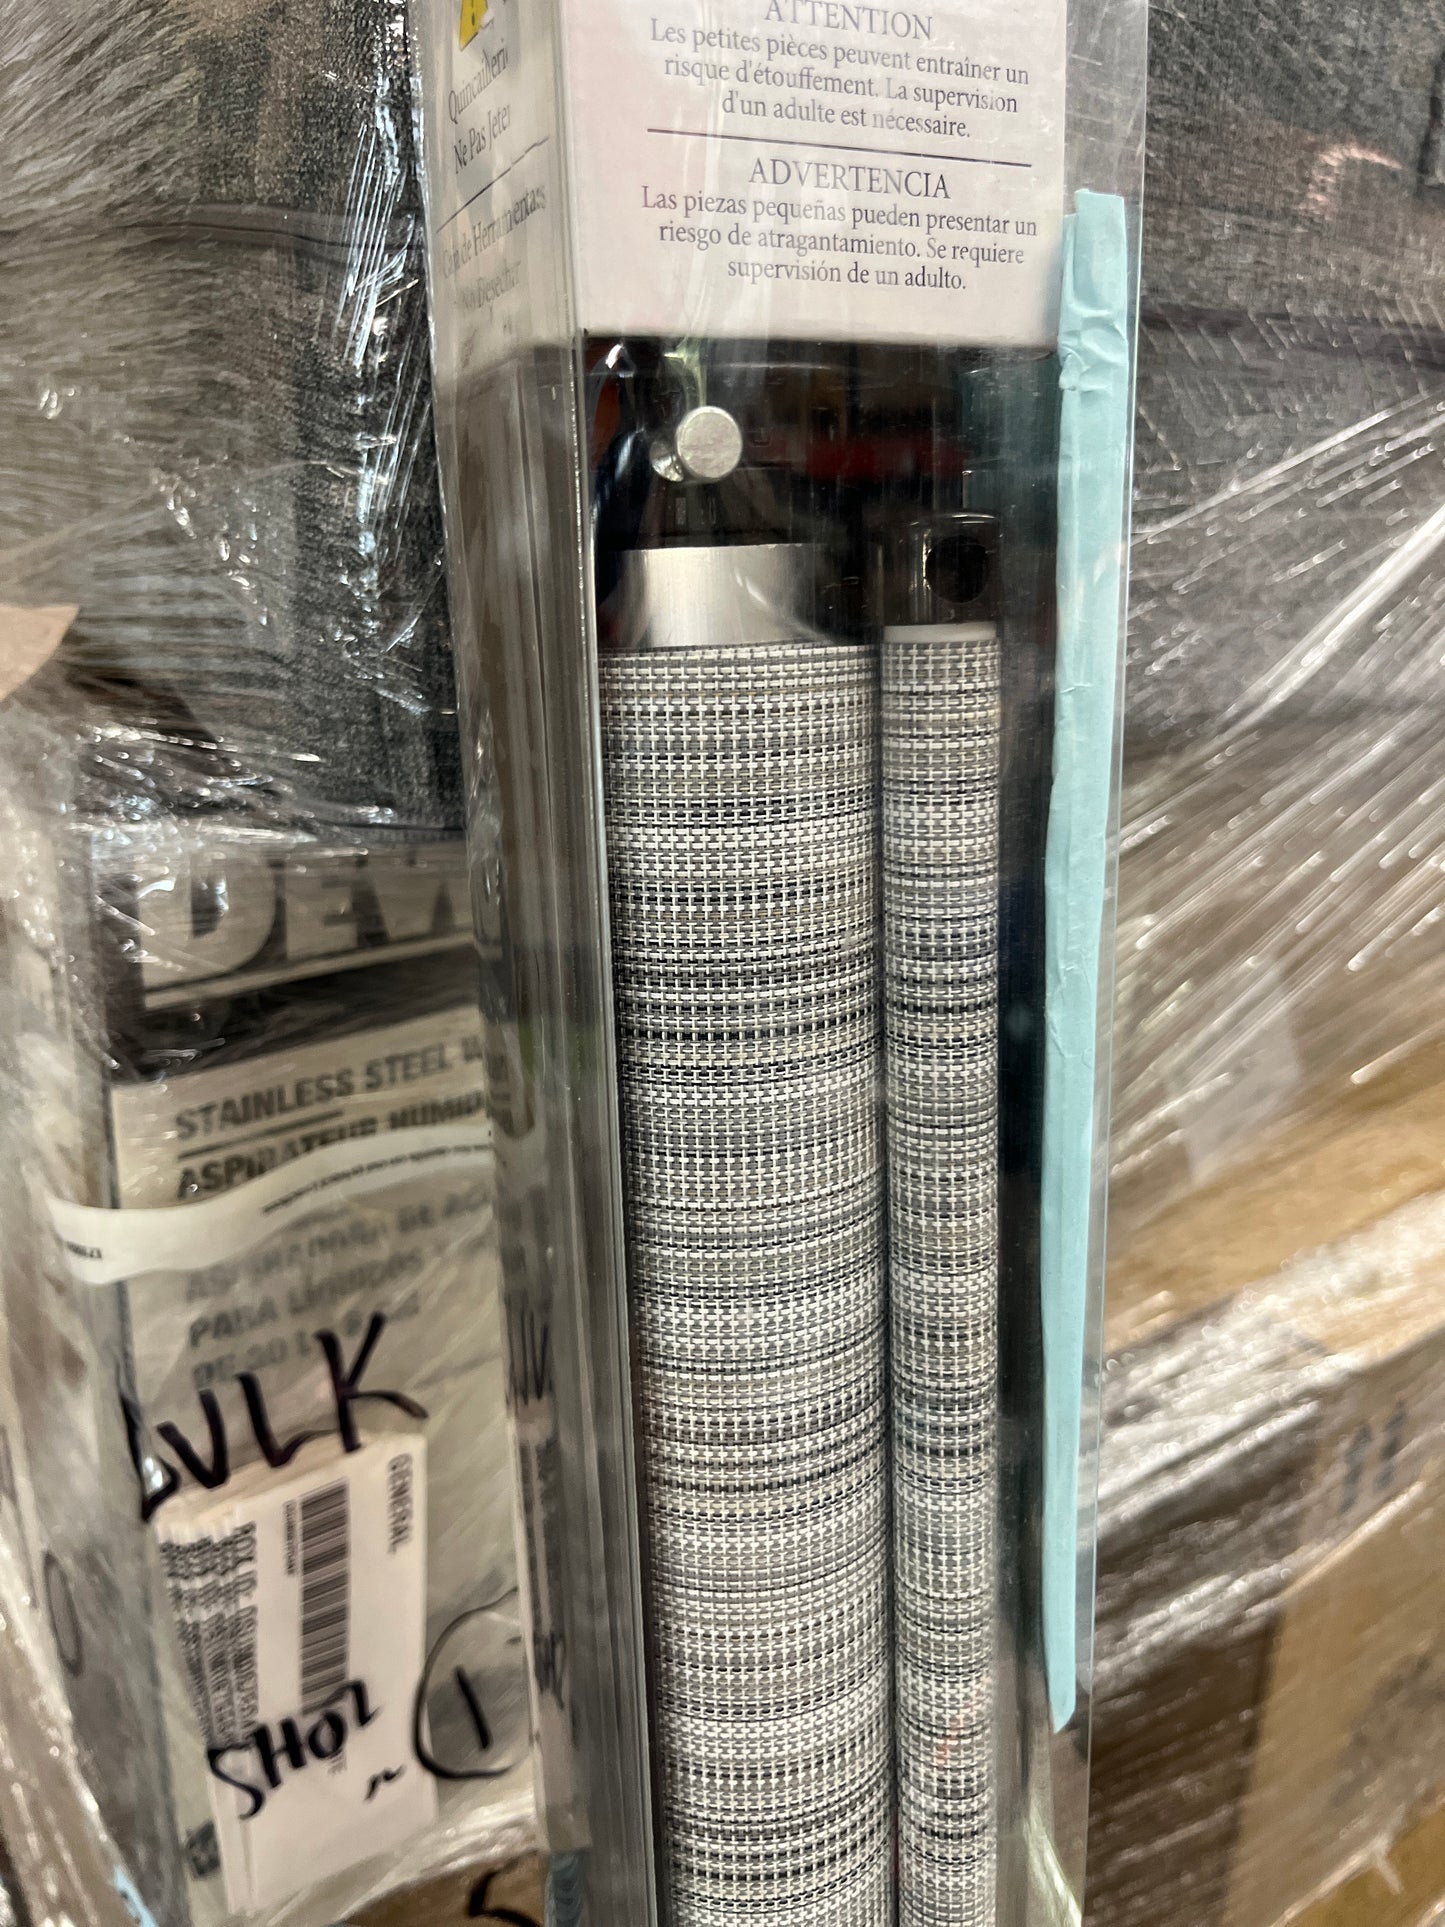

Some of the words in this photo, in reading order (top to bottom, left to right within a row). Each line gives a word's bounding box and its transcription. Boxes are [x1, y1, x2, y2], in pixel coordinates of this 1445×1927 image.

[764, 0, 933, 40] ATTENTION
[650, 18, 686, 43] Les
[692, 28, 760, 53] petites
[766, 34, 827, 61] pièces
[833, 46, 911, 70] peuvent
[916, 57, 1000, 81] entraîner
[1006, 68, 1029, 85] un
[665, 54, 729, 86] risque
[735, 60, 879, 97] d'étouffement.
[886, 78, 907, 100] La
[913, 86, 1017, 113] supervision
[722, 90, 766, 116] d'un
[773, 97, 835, 124] adulte
[841, 108, 866, 126] est
[873, 108, 970, 137] nécessaire.
[454, 139, 467, 174] Ne
[469, 128, 486, 160] Pas
[749, 157, 951, 199] ADVERTENCIA
[641, 185, 677, 209] Las
[684, 191, 747, 218] piezas
[753, 200, 846, 225] pequeñas
[852, 203, 920, 229] pueden
[926, 213, 1009, 235] presentar
[1015, 221, 1037, 236] un
[659, 221, 721, 250] riesgo
[728, 223, 751, 245] de
[758, 230, 921, 257] atragantamiento.
[926, 238, 947, 259] Se
[952, 243, 1024, 268] requiere
[728, 259, 841, 284] supervisión
[847, 262, 869, 284] de
[875, 270, 898, 286] un
[904, 266, 966, 290] adulto.
[175, 1068, 355, 1141] STAINLESS
[365, 1042, 452, 1091] STEEL
